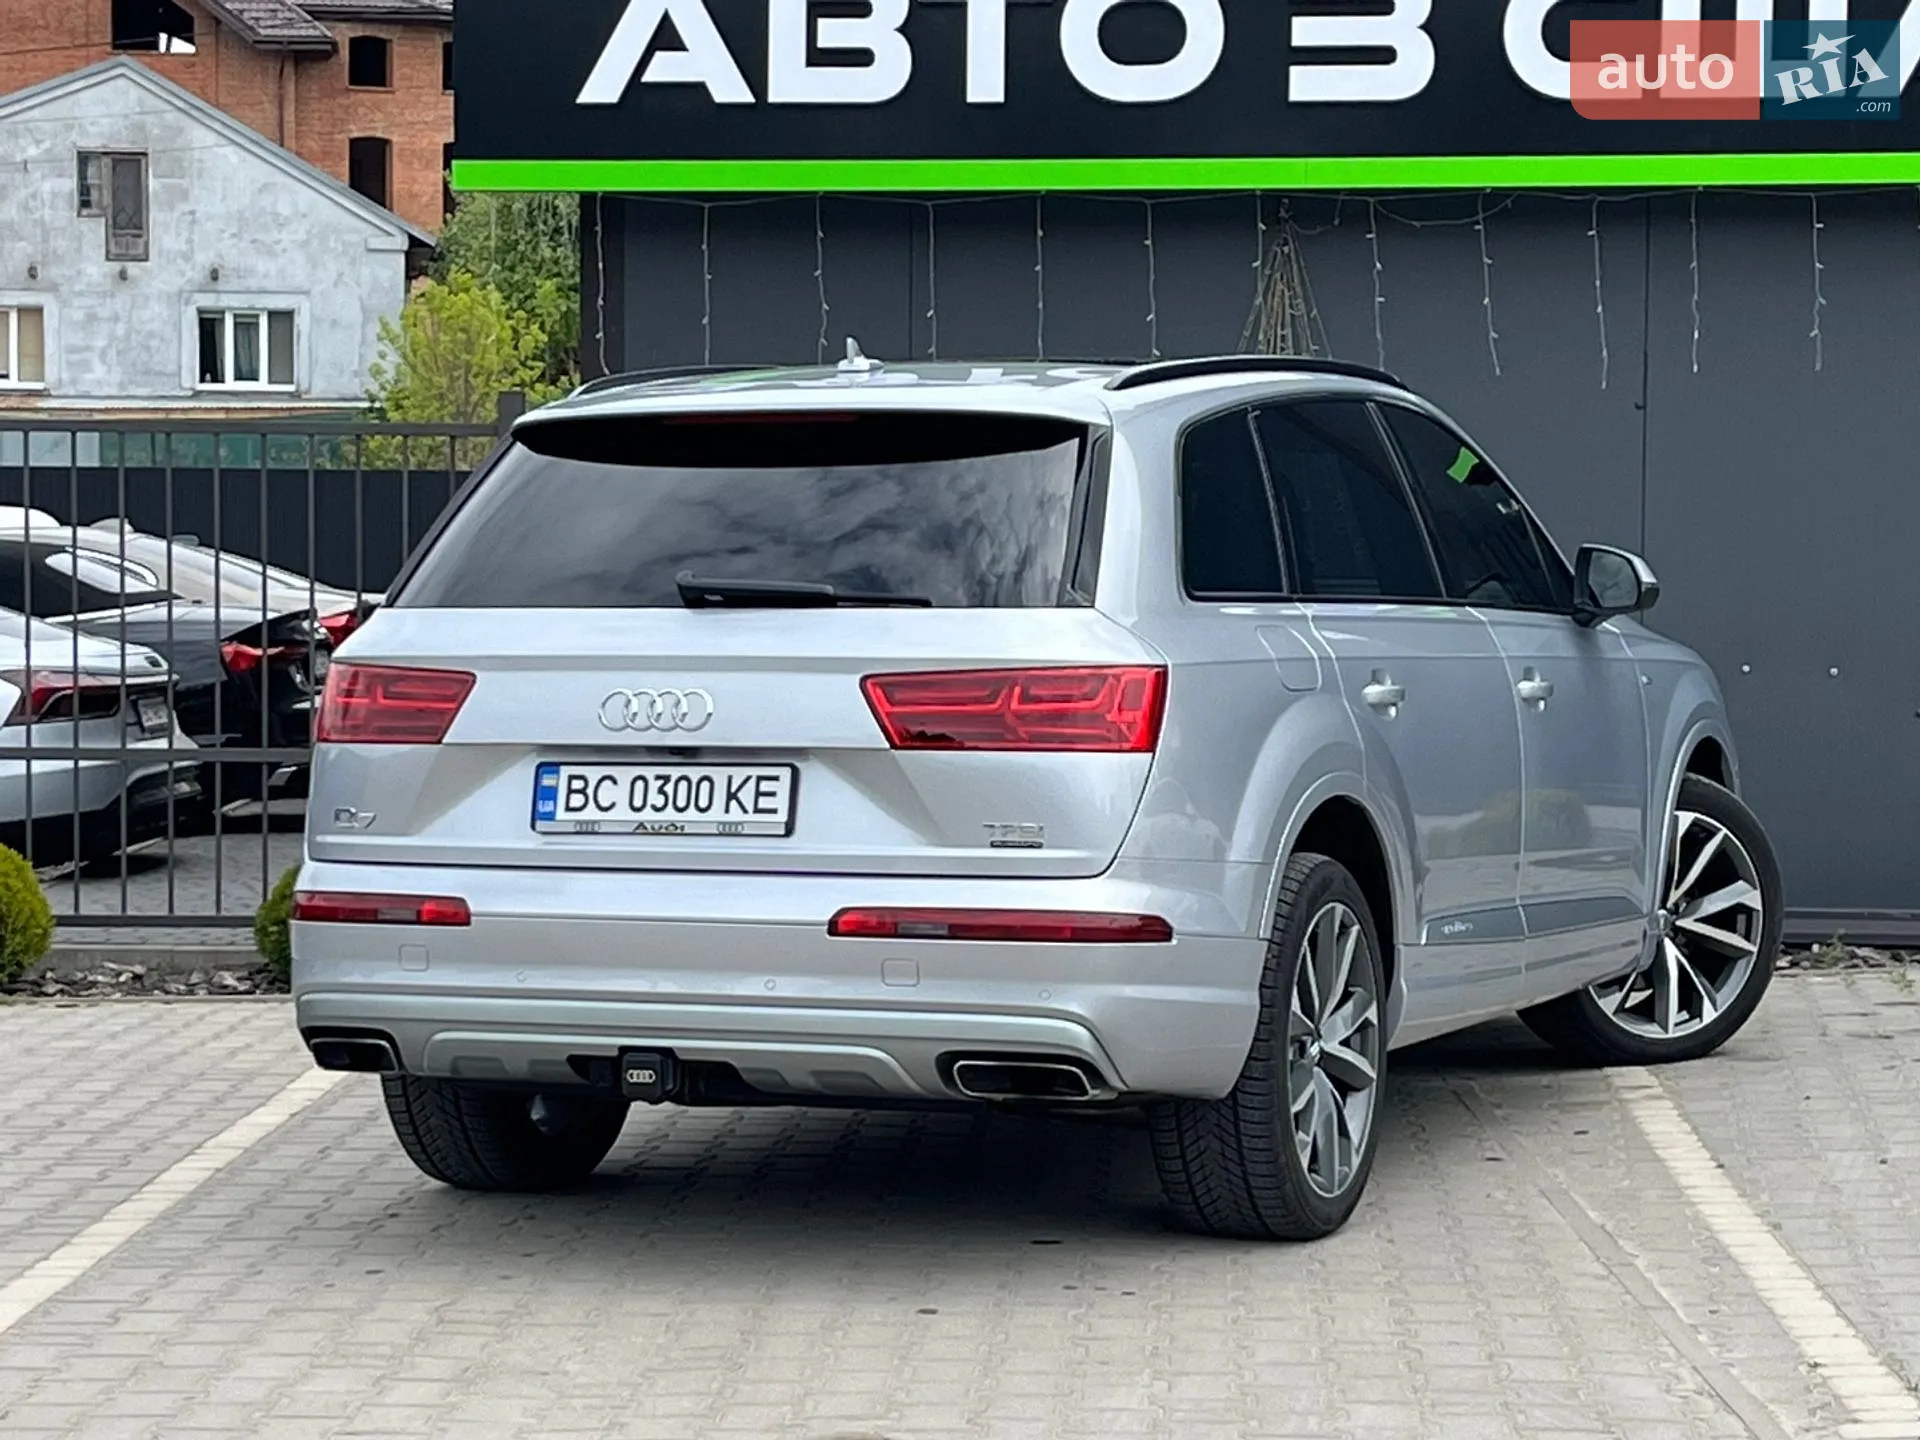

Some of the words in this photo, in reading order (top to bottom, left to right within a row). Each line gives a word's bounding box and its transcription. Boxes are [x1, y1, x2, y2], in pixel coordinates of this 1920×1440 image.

[575, 0, 1226, 104] АВТО
[564, 774, 619, 813] BC
[627, 774, 716, 814] 0300
[724, 774, 781, 815] KE
